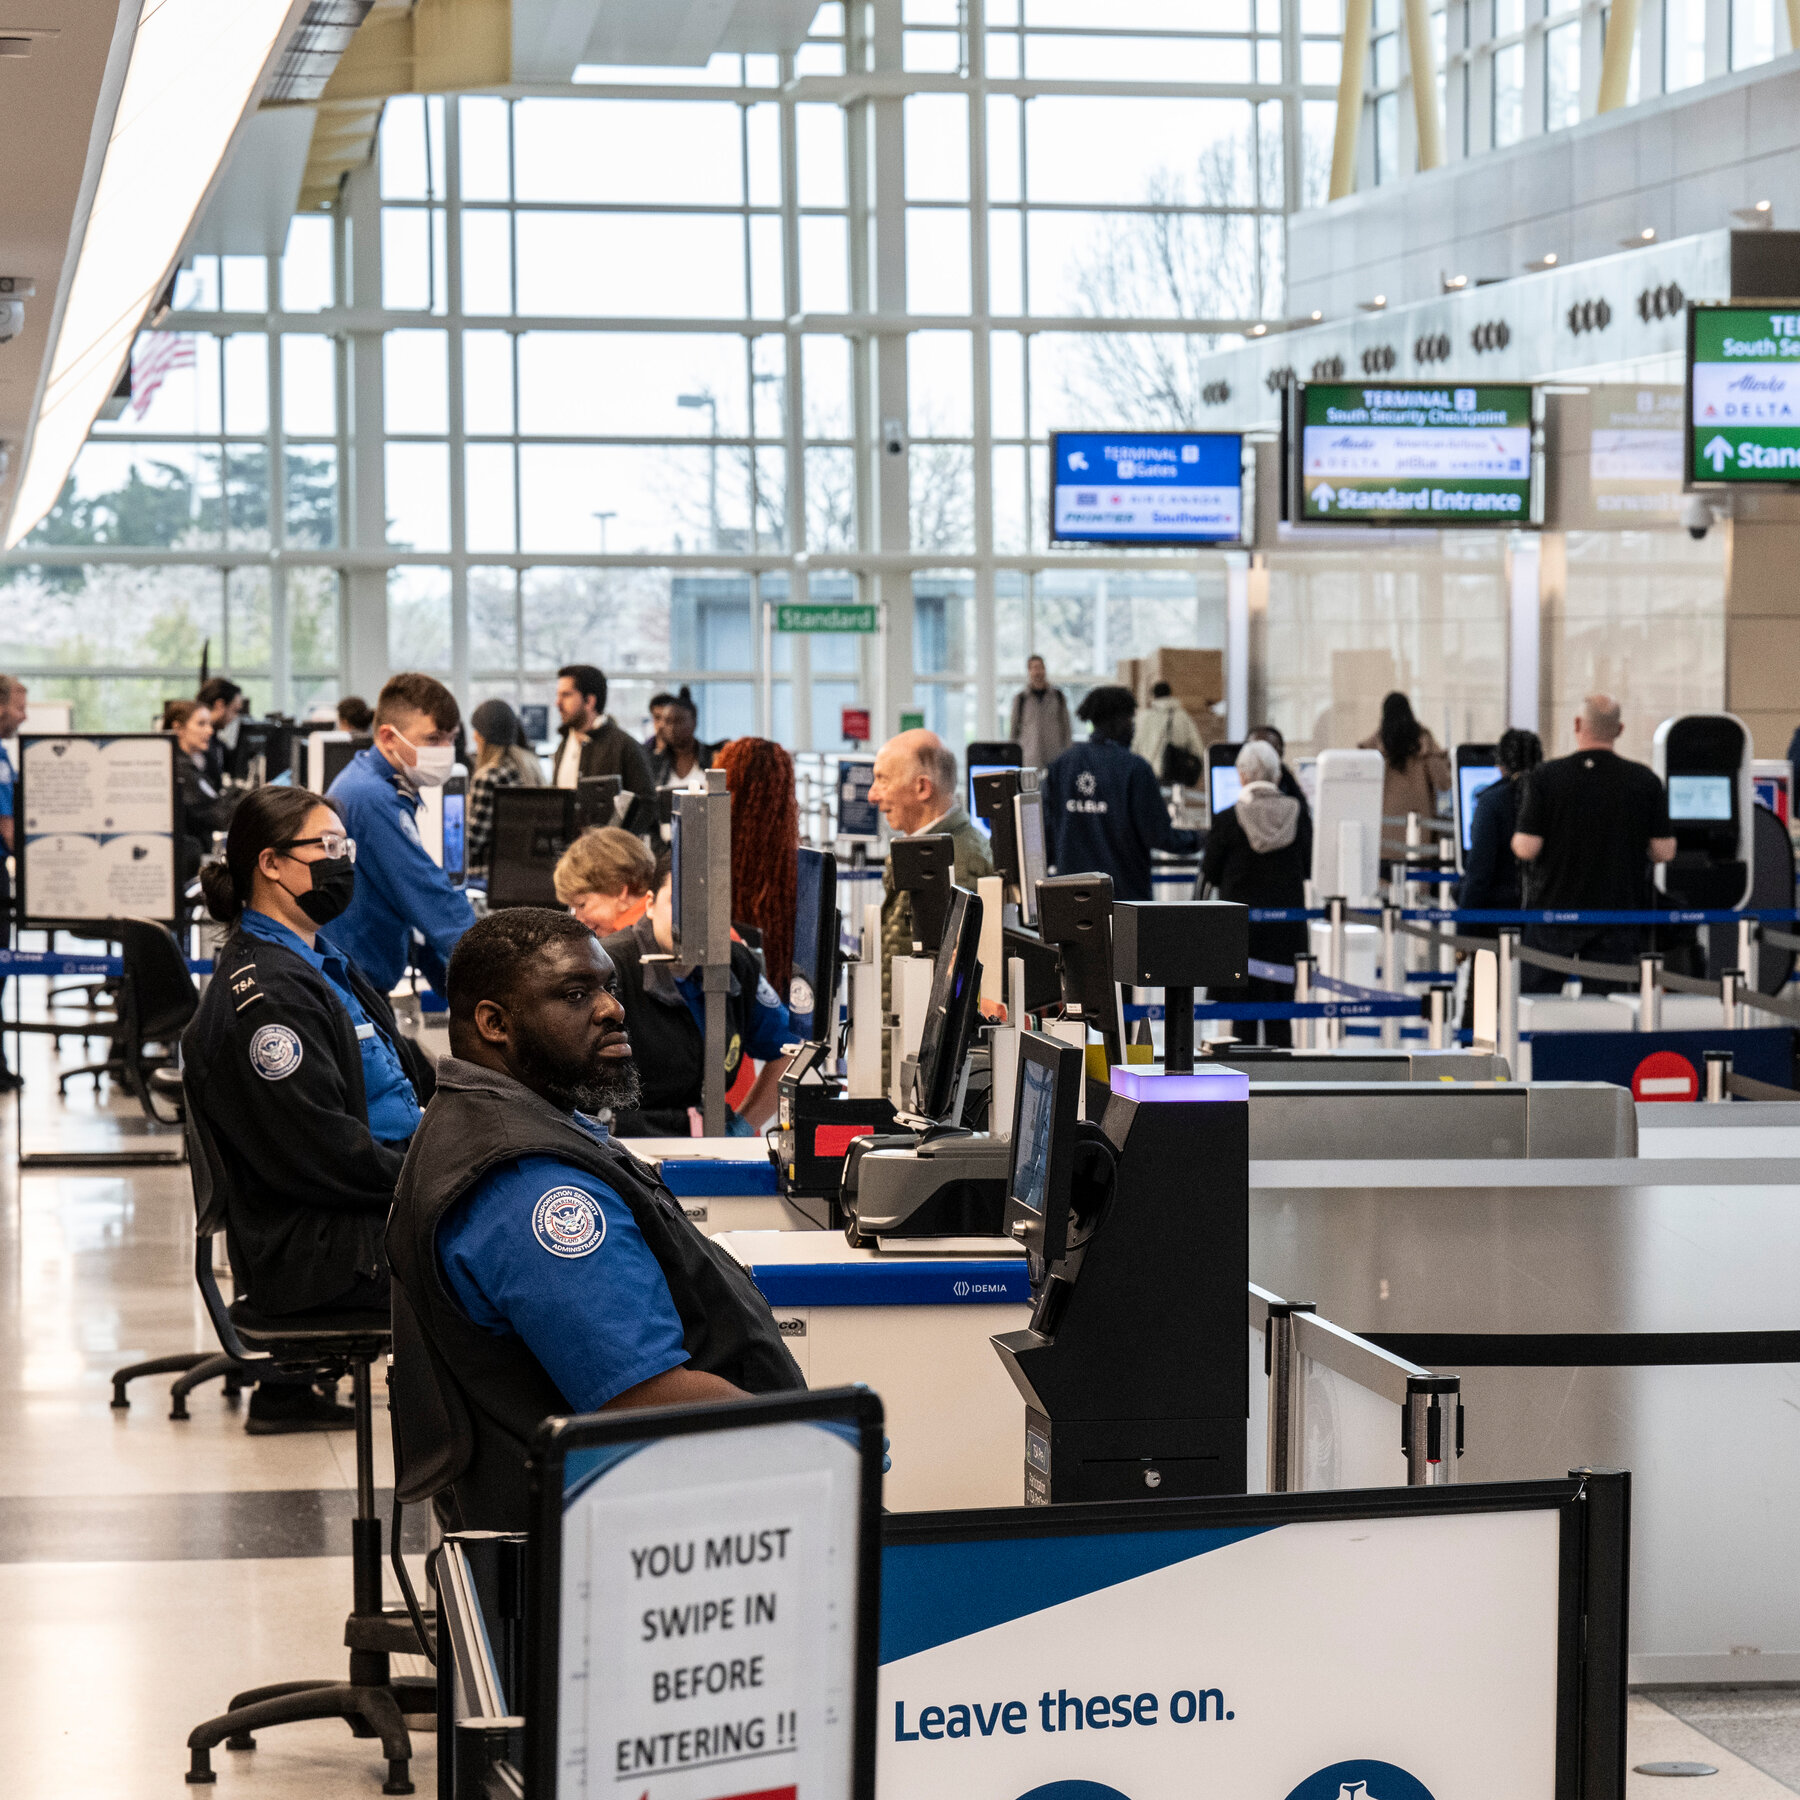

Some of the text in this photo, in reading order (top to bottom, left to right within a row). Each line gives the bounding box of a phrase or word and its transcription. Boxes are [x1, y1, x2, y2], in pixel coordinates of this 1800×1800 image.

[1723, 337, 1777, 357] South
[1363, 388, 1452, 409] TERMINAL
[1725, 404, 1791, 416] DELTA
[1327, 407, 1508, 427] South Security Checkpoint
[1103, 445, 1178, 462] TERMINAL
[1737, 441, 1800, 469] Stan
[1134, 462, 1178, 478] Gates
[1337, 487, 1522, 512] Standard Entrance
[781, 607, 872, 630] Standard
[232, 977, 256, 994] TSA
[1340, 1004, 1371, 1015] CLEAR
[537, 1190, 599, 1233] TRANSPORTATION SECURITY
[552, 1230, 601, 1253] ADMINISTRATION
[971, 1284, 1008, 1293] IDEMIA
[631, 1527, 792, 1580] YOU MUST
[641, 1592, 778, 1643] SWIPE IN
[652, 1655, 764, 1704] BEFORE
[895, 1686, 1236, 1742] Leave these on.
[615, 1716, 766, 1773] ENTERING
[777, 1710, 798, 1745] !!
